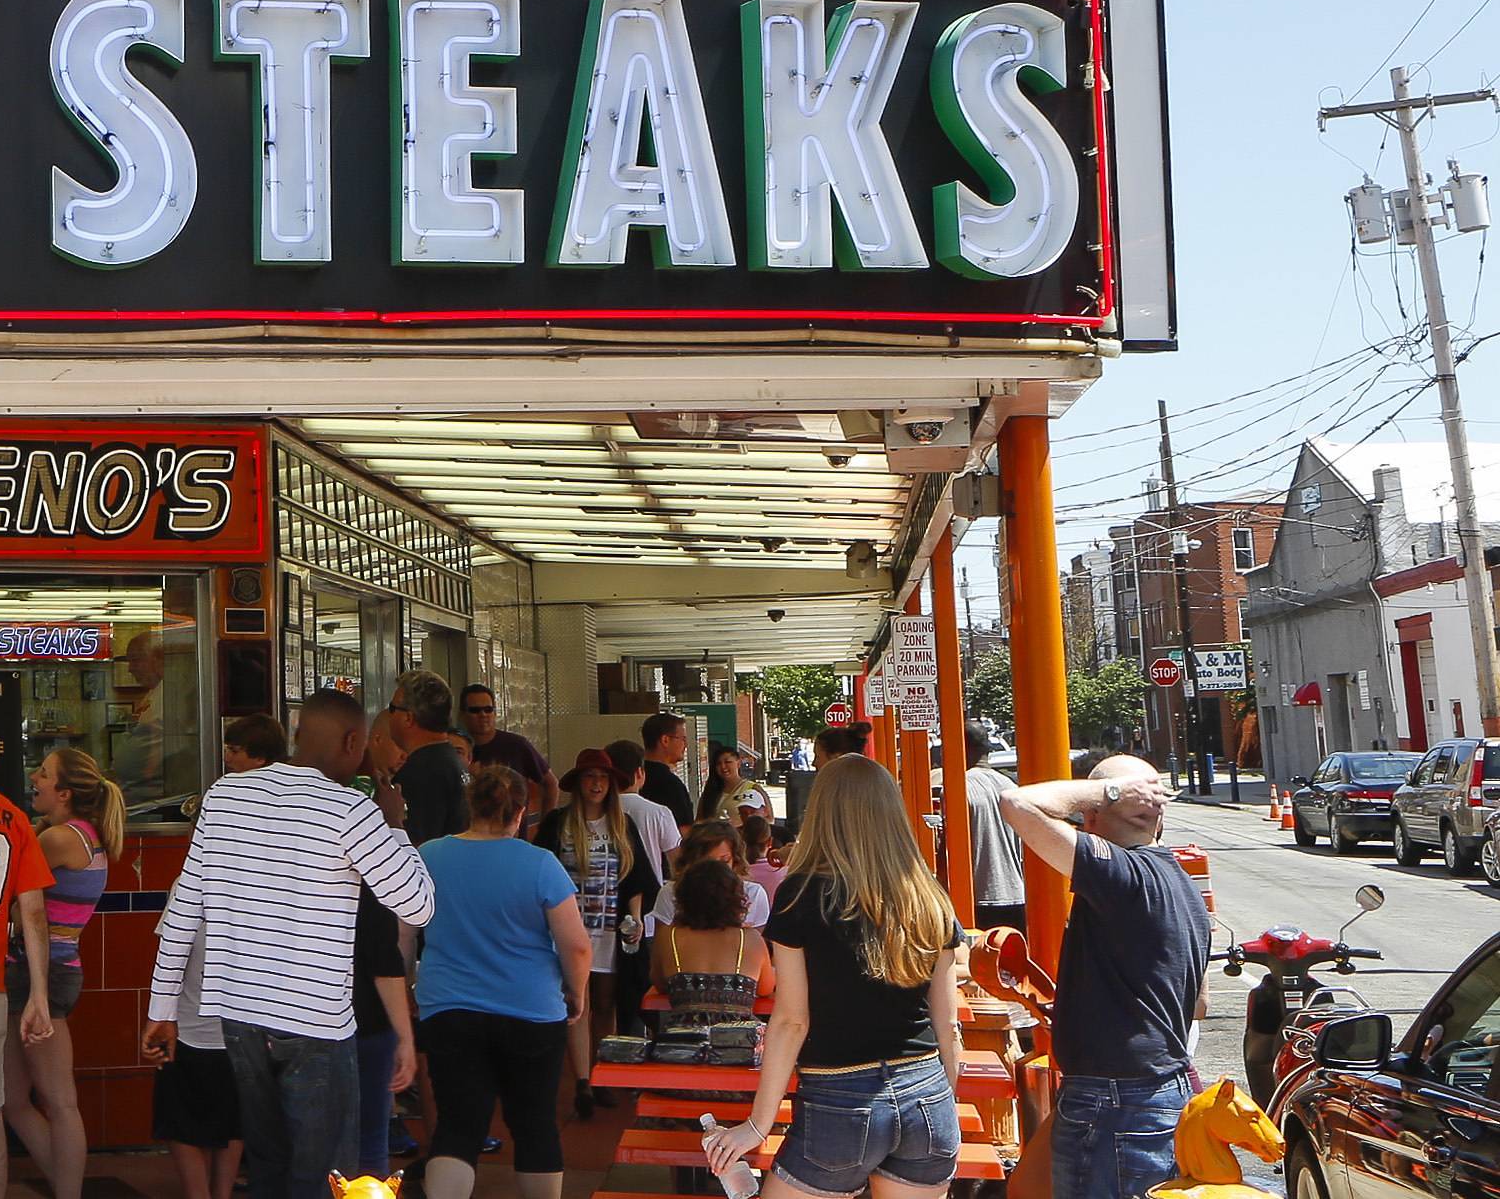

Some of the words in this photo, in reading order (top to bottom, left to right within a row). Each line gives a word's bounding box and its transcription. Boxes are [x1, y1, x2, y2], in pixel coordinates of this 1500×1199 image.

[895, 621, 934, 633] LOADING
[903, 635, 928, 647] ZONE
[899, 651, 912, 663] 20
[1206, 653, 1219, 667] &
[1223, 652, 1243, 666] M
[896, 664, 936, 677] PARKING
[1152, 667, 1178, 678] STOP
[1216, 667, 1244, 679] Body
[907, 686, 926, 695] NO
[827, 711, 851, 722] STOP
